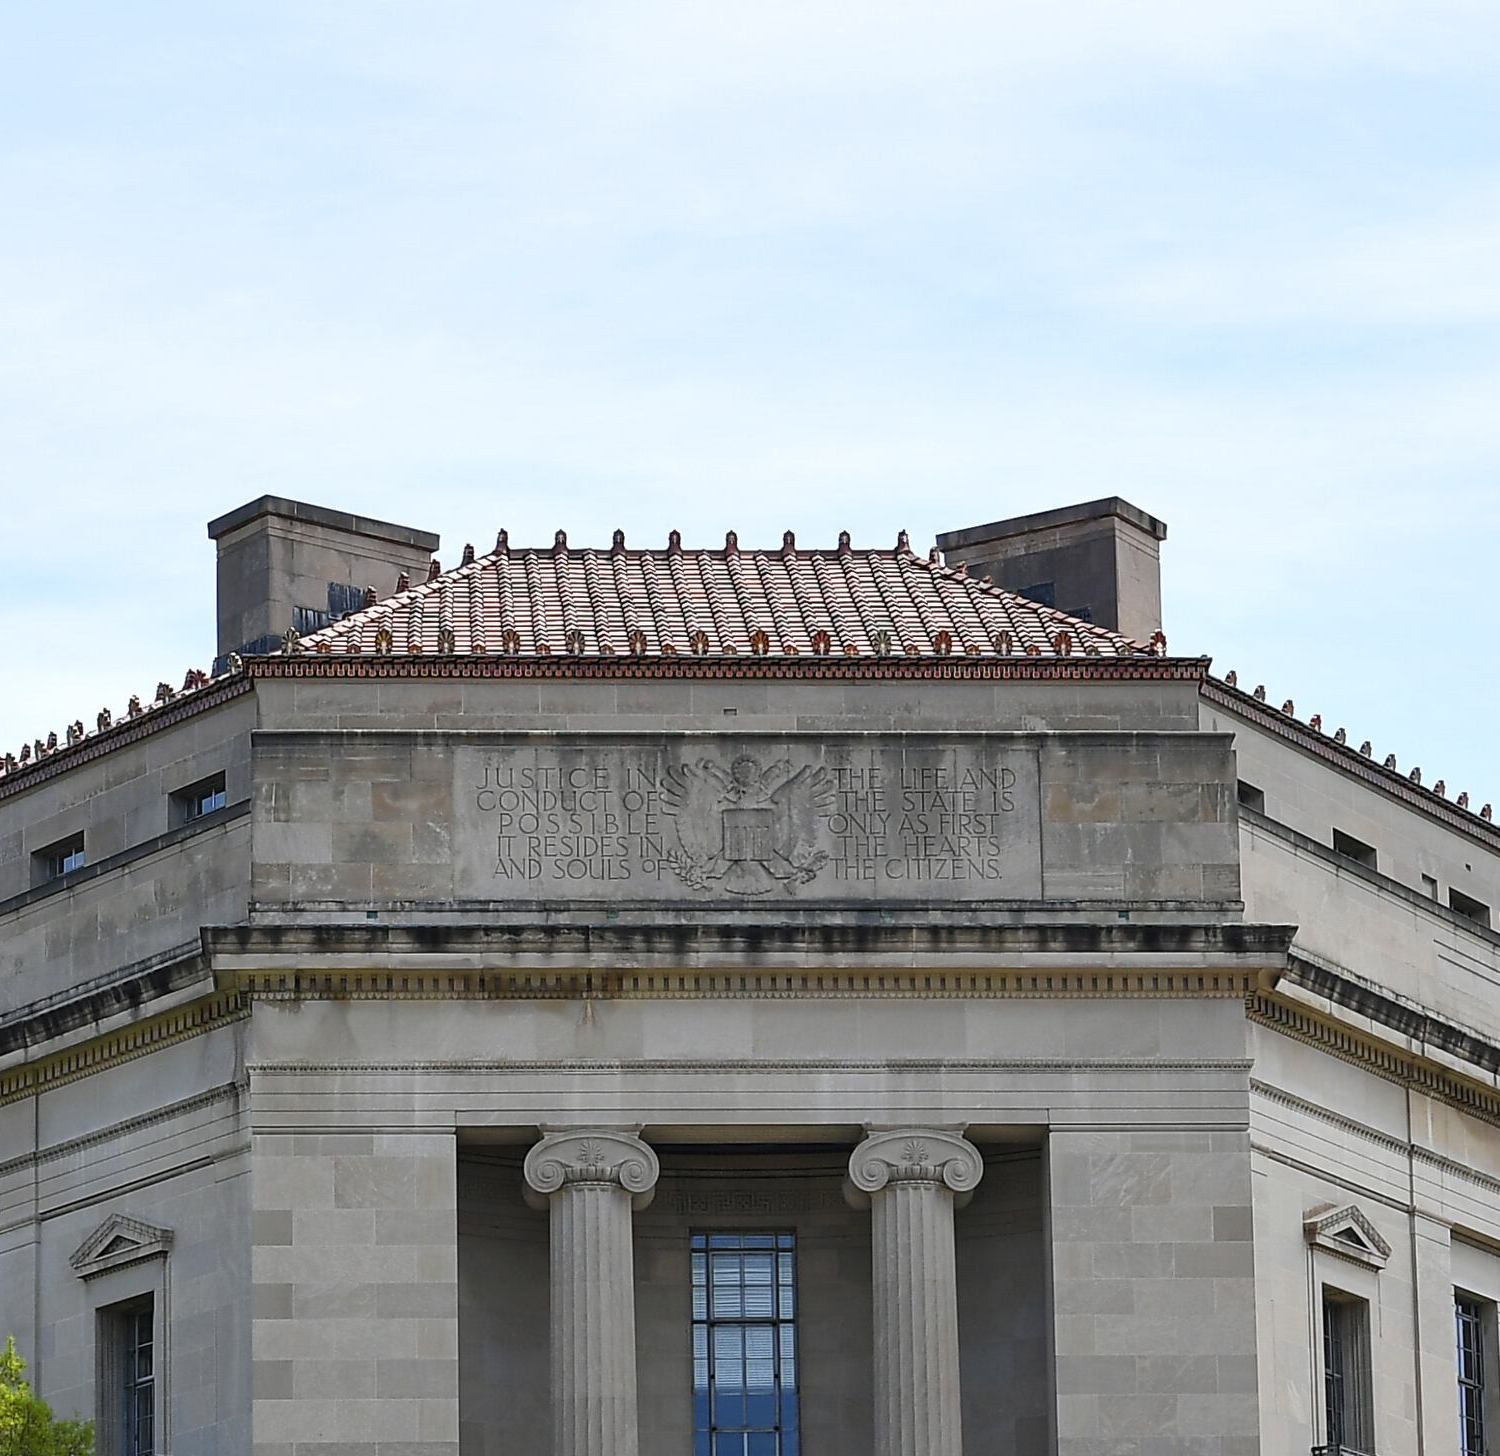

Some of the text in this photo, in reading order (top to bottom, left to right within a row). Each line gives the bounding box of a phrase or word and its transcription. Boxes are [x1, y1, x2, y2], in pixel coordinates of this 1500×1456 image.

[476, 768, 1016, 789] JUSTICE IN THE LIFE AND
[477, 791, 1015, 812] CONDUCT OF THE STATE IS
[500, 813, 1000, 835] POSSIBLE ONLY AS FIRST
[498, 836, 1000, 858] IT RESIDES IN THE HEARTS
[493, 858, 1003, 880] AND SOULS OF THE CITIZENS.
